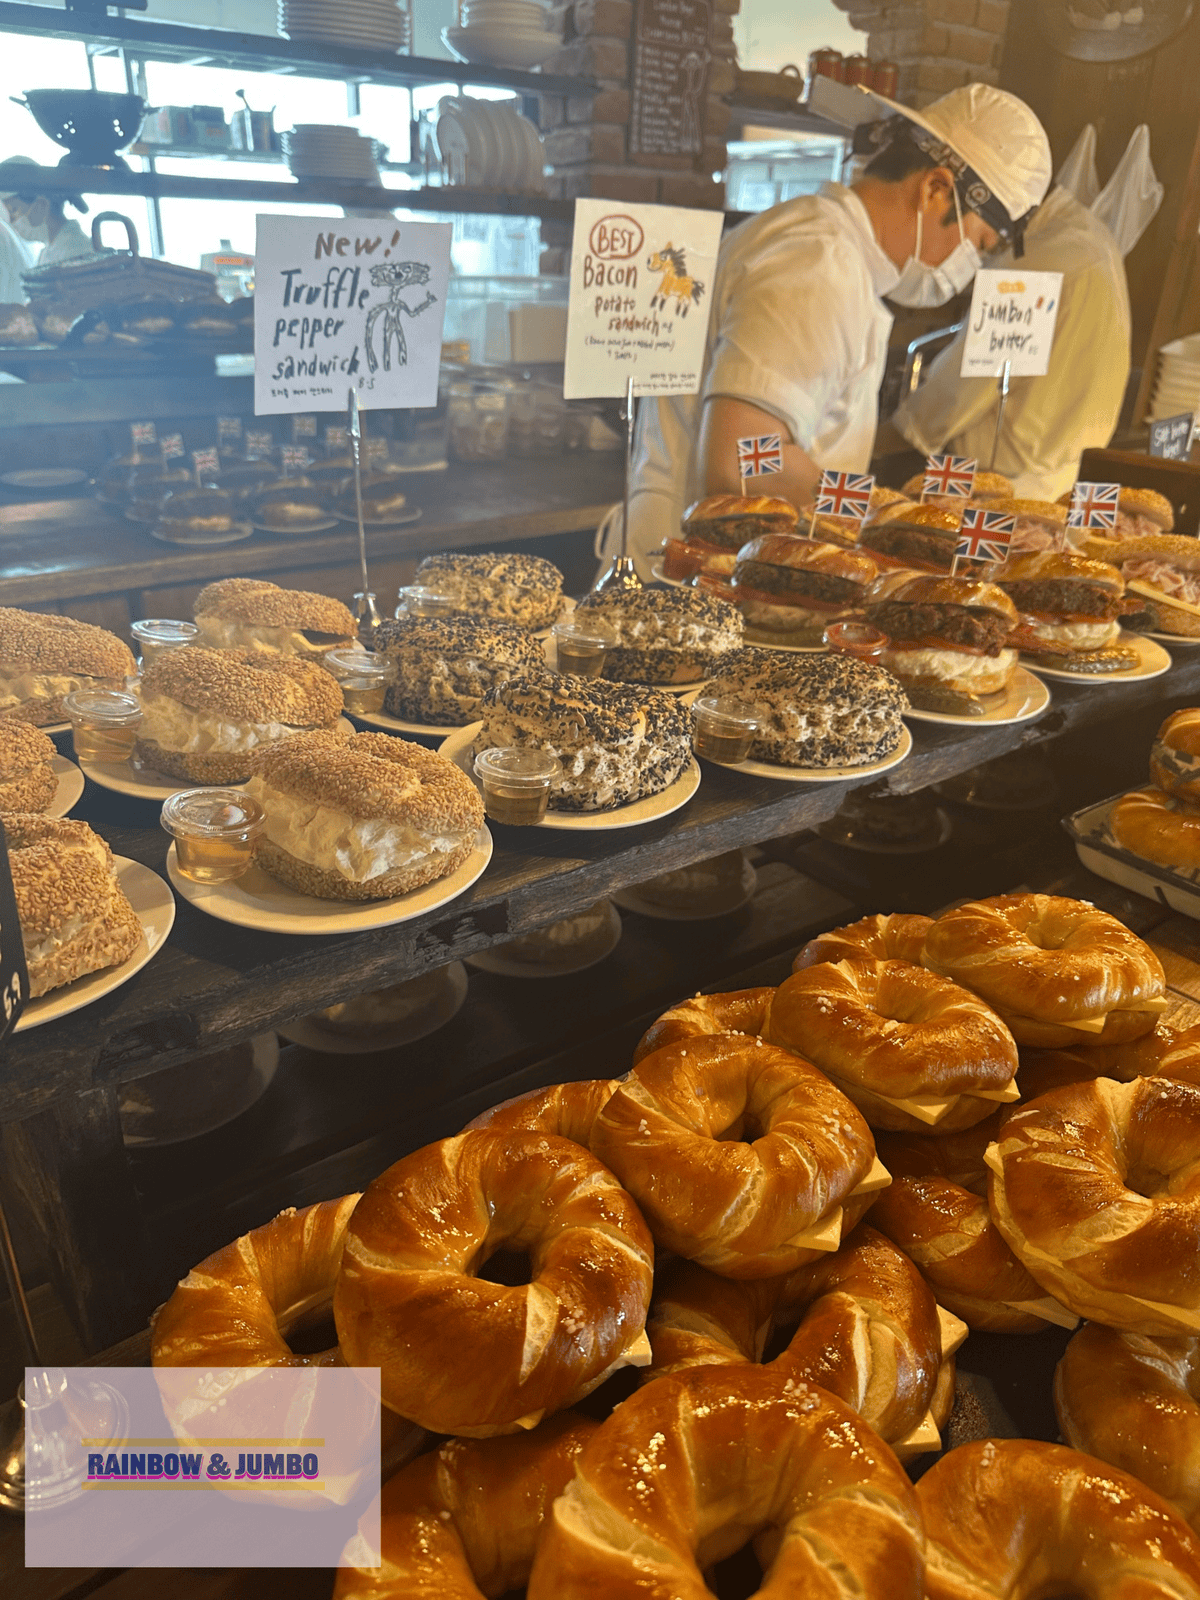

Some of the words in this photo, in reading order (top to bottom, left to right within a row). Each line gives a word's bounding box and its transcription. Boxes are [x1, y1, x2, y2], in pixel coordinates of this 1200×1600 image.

[315, 229, 401, 260] New!
[598, 224, 635, 254] BEST
[281, 266, 370, 310] Truffle
[583, 255, 638, 290] Bacon
[594, 295, 636, 319] potato
[608, 309, 660, 337] sandwich
[973, 298, 1033, 333] jambon
[273, 316, 345, 350] pepper
[989, 330, 1033, 353] butter
[272, 345, 360, 380] sandwich
